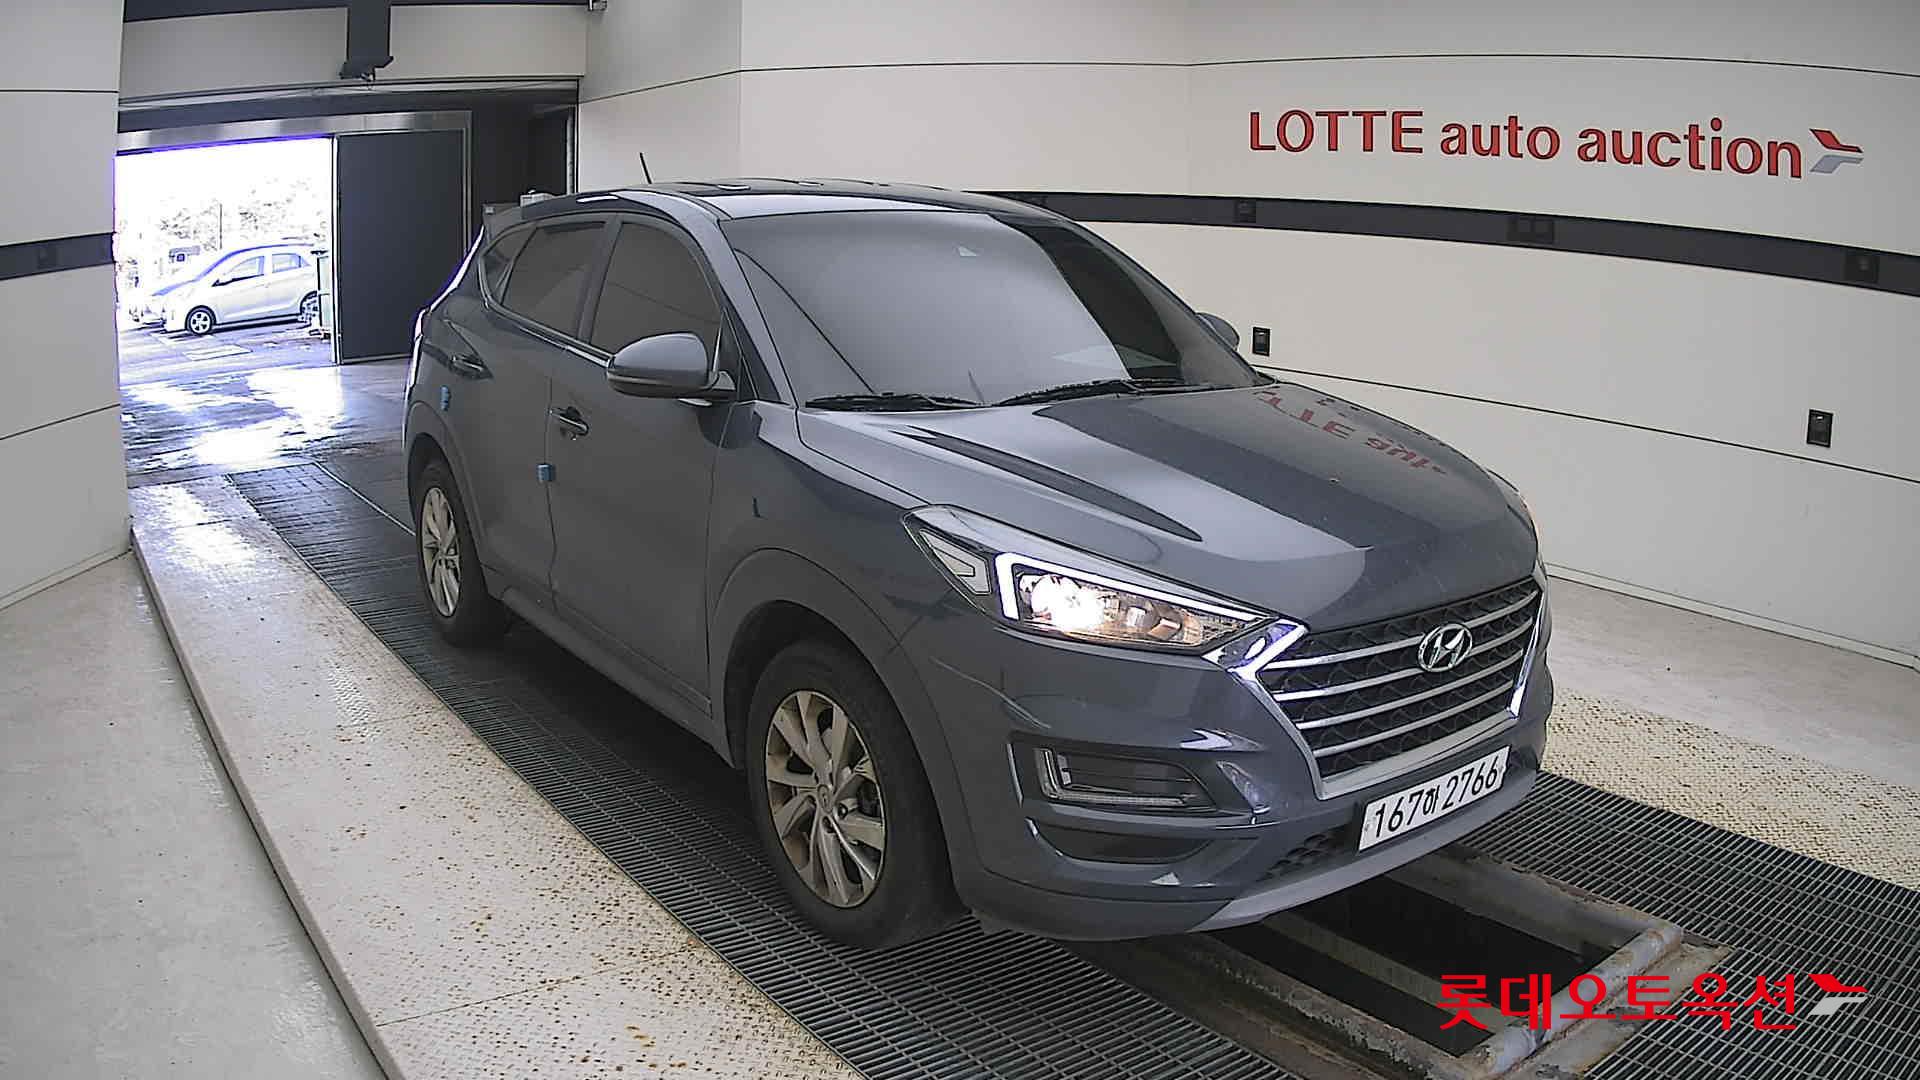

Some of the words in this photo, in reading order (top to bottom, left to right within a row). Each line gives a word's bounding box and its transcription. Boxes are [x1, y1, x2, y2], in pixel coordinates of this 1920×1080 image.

[1248, 109, 1423, 154] LOTTE
[1440, 115, 1561, 161] auto
[1576, 117, 1803, 180] auction
